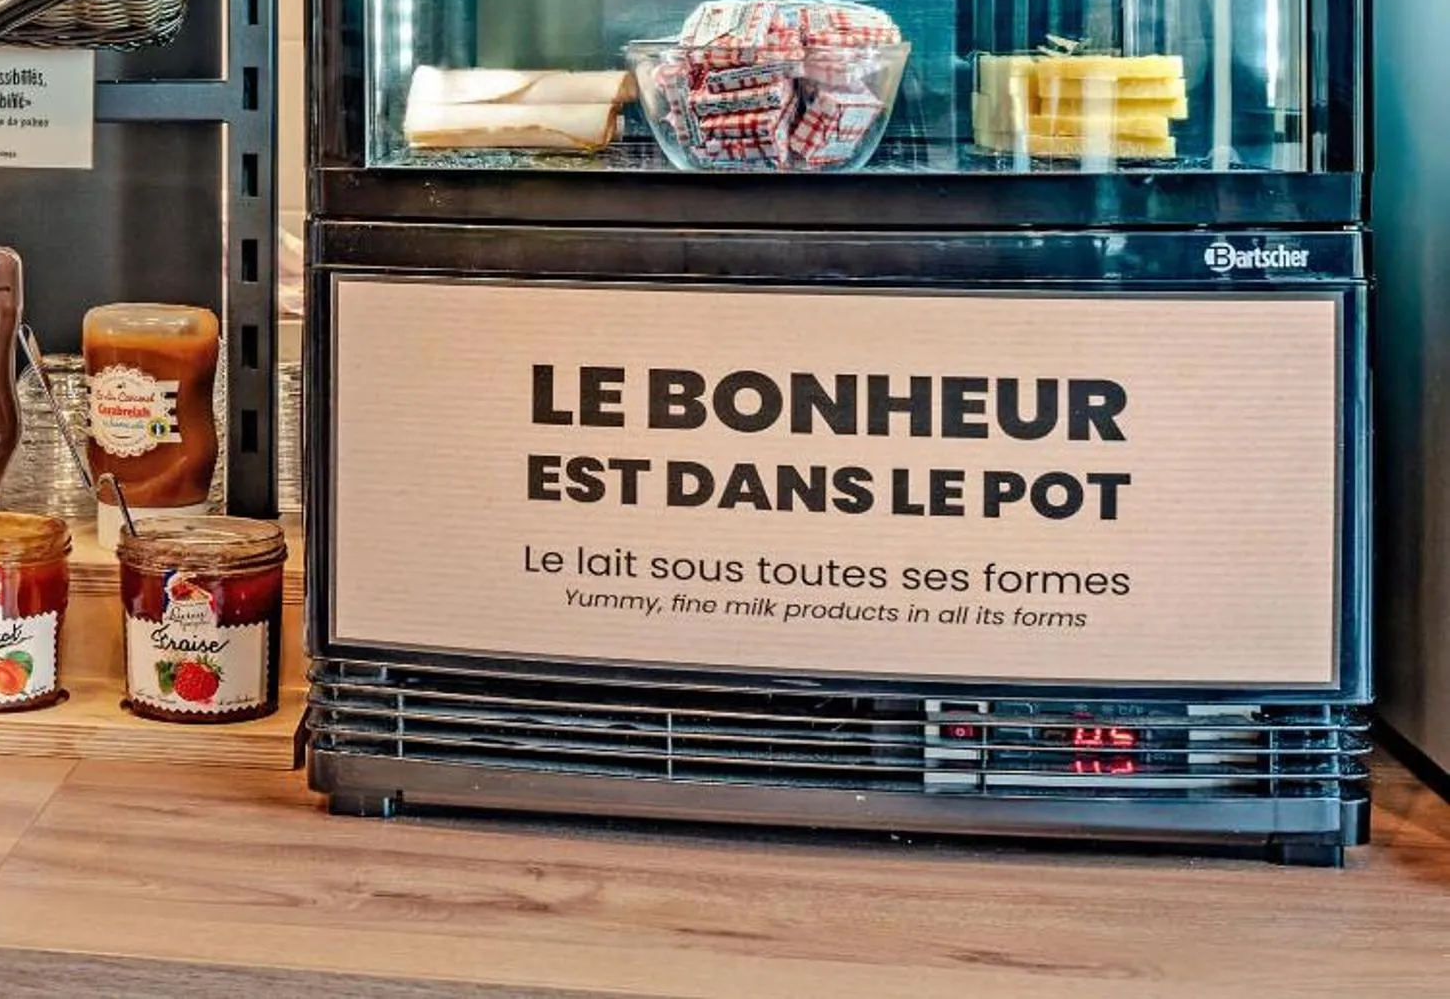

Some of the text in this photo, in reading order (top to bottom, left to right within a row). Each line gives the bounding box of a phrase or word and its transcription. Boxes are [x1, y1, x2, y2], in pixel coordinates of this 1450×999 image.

[1204, 241, 1310, 273] Bartscher
[531, 364, 1127, 441] LE BONHEUR
[526, 454, 1132, 521] EST DANS LE POT
[525, 545, 1131, 596] Le lait sous toutes ses formes
[566, 588, 1088, 628] Yummy, fine milk products in all its forms
[150, 623, 230, 654] Fraise
